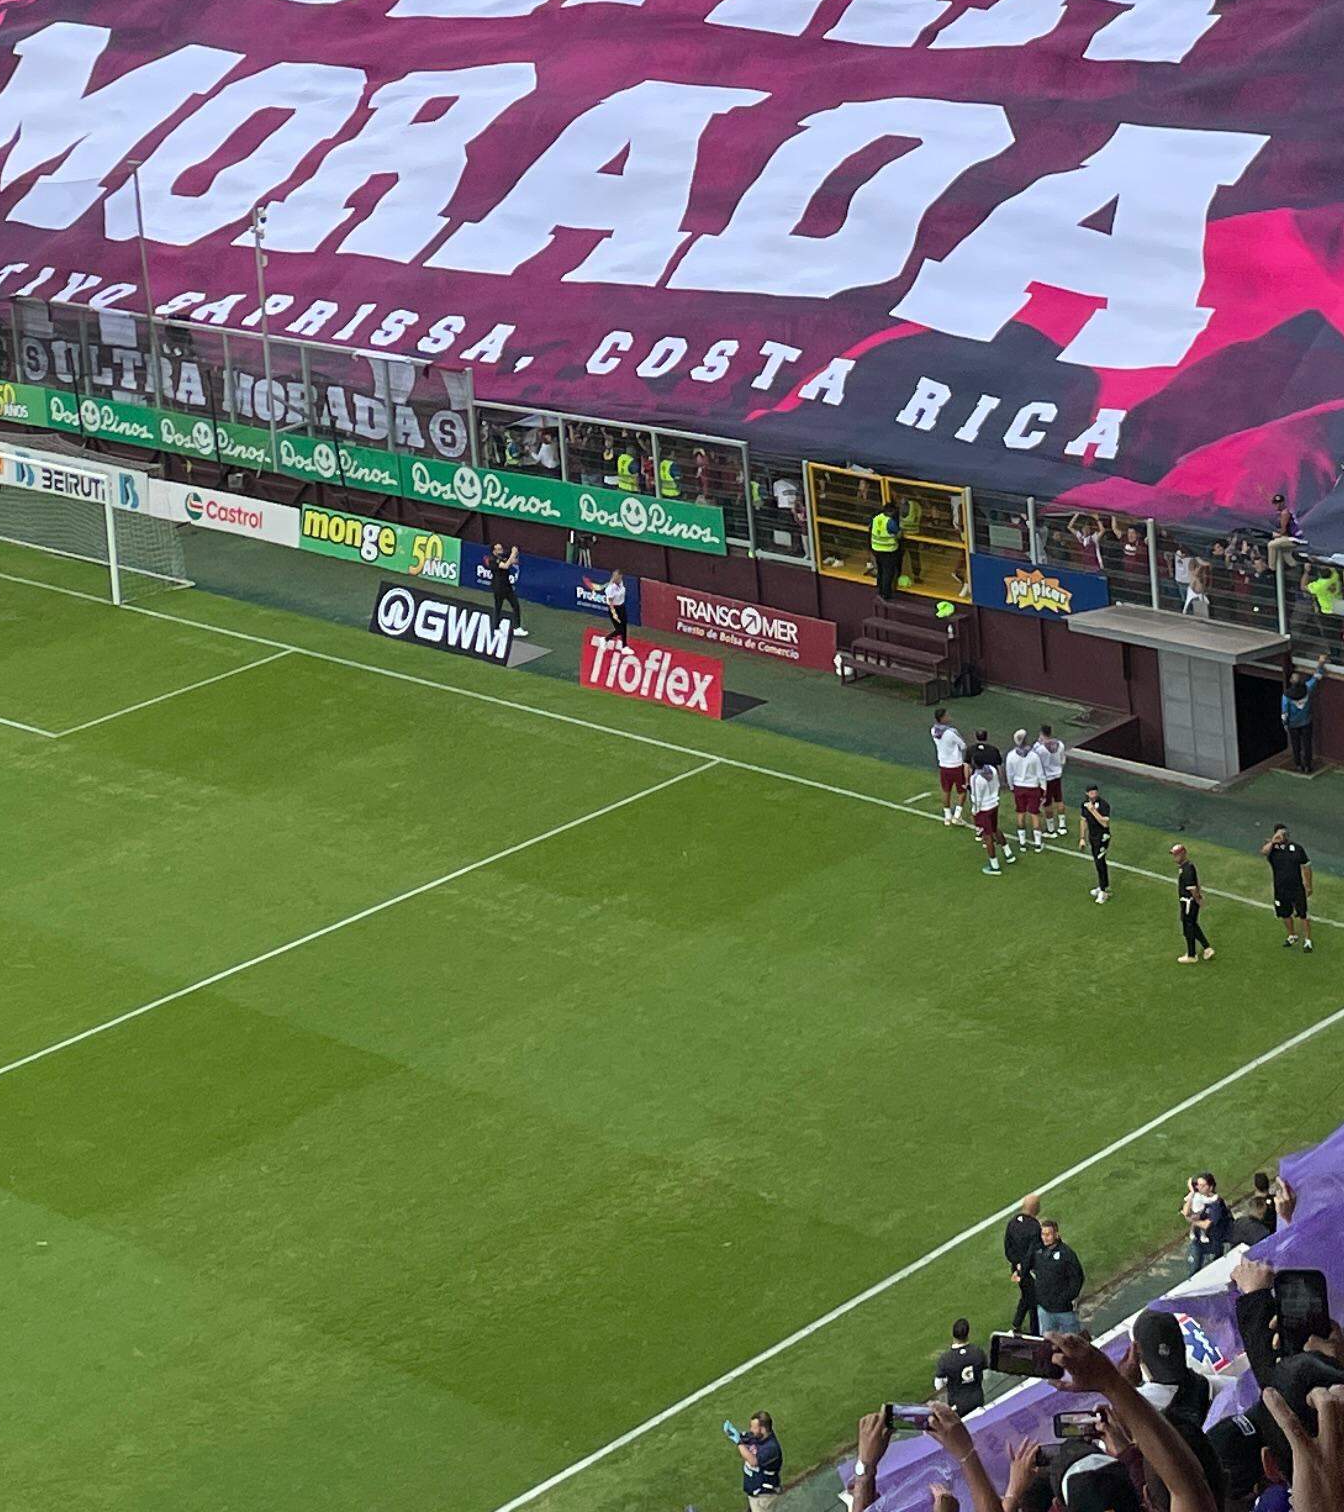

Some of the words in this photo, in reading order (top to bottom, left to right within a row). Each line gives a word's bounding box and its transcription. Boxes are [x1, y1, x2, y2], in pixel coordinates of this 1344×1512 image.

[50, 340, 207, 406] ULTRA
[222, 369, 425, 449] MORADA
[156, 291, 534, 372] SAPRISSA,
[586, 331, 856, 406] COSTA
[896, 378, 1128, 459] RICA
[50, 396, 81, 426] Dos
[101, 405, 155, 440] Pinos
[161, 418, 194, 448] Dos
[216, 428, 272, 464] Pinos
[41, 468, 103, 501] BEIRUT
[280, 440, 317, 471] Dos
[336, 449, 398, 486] Pinos
[411, 462, 456, 499] Dos
[482, 473, 560, 517] Pinos
[206, 500, 263, 530] Castrol
[303, 508, 396, 561] monge
[579, 493, 623, 527] Dos
[647, 504, 720, 544] Pinos
[409, 534, 443, 576] 50
[422, 553, 457, 580] AÑOS
[413, 599, 511, 660] GWM
[676, 595, 799, 644] TRANSCOMER
[676, 621, 705, 637] Puesto
[706, 629, 718, 640] de
[719, 632, 743, 646] Bolsa
[744, 638, 756, 649] de
[757, 641, 800, 660] Comercio
